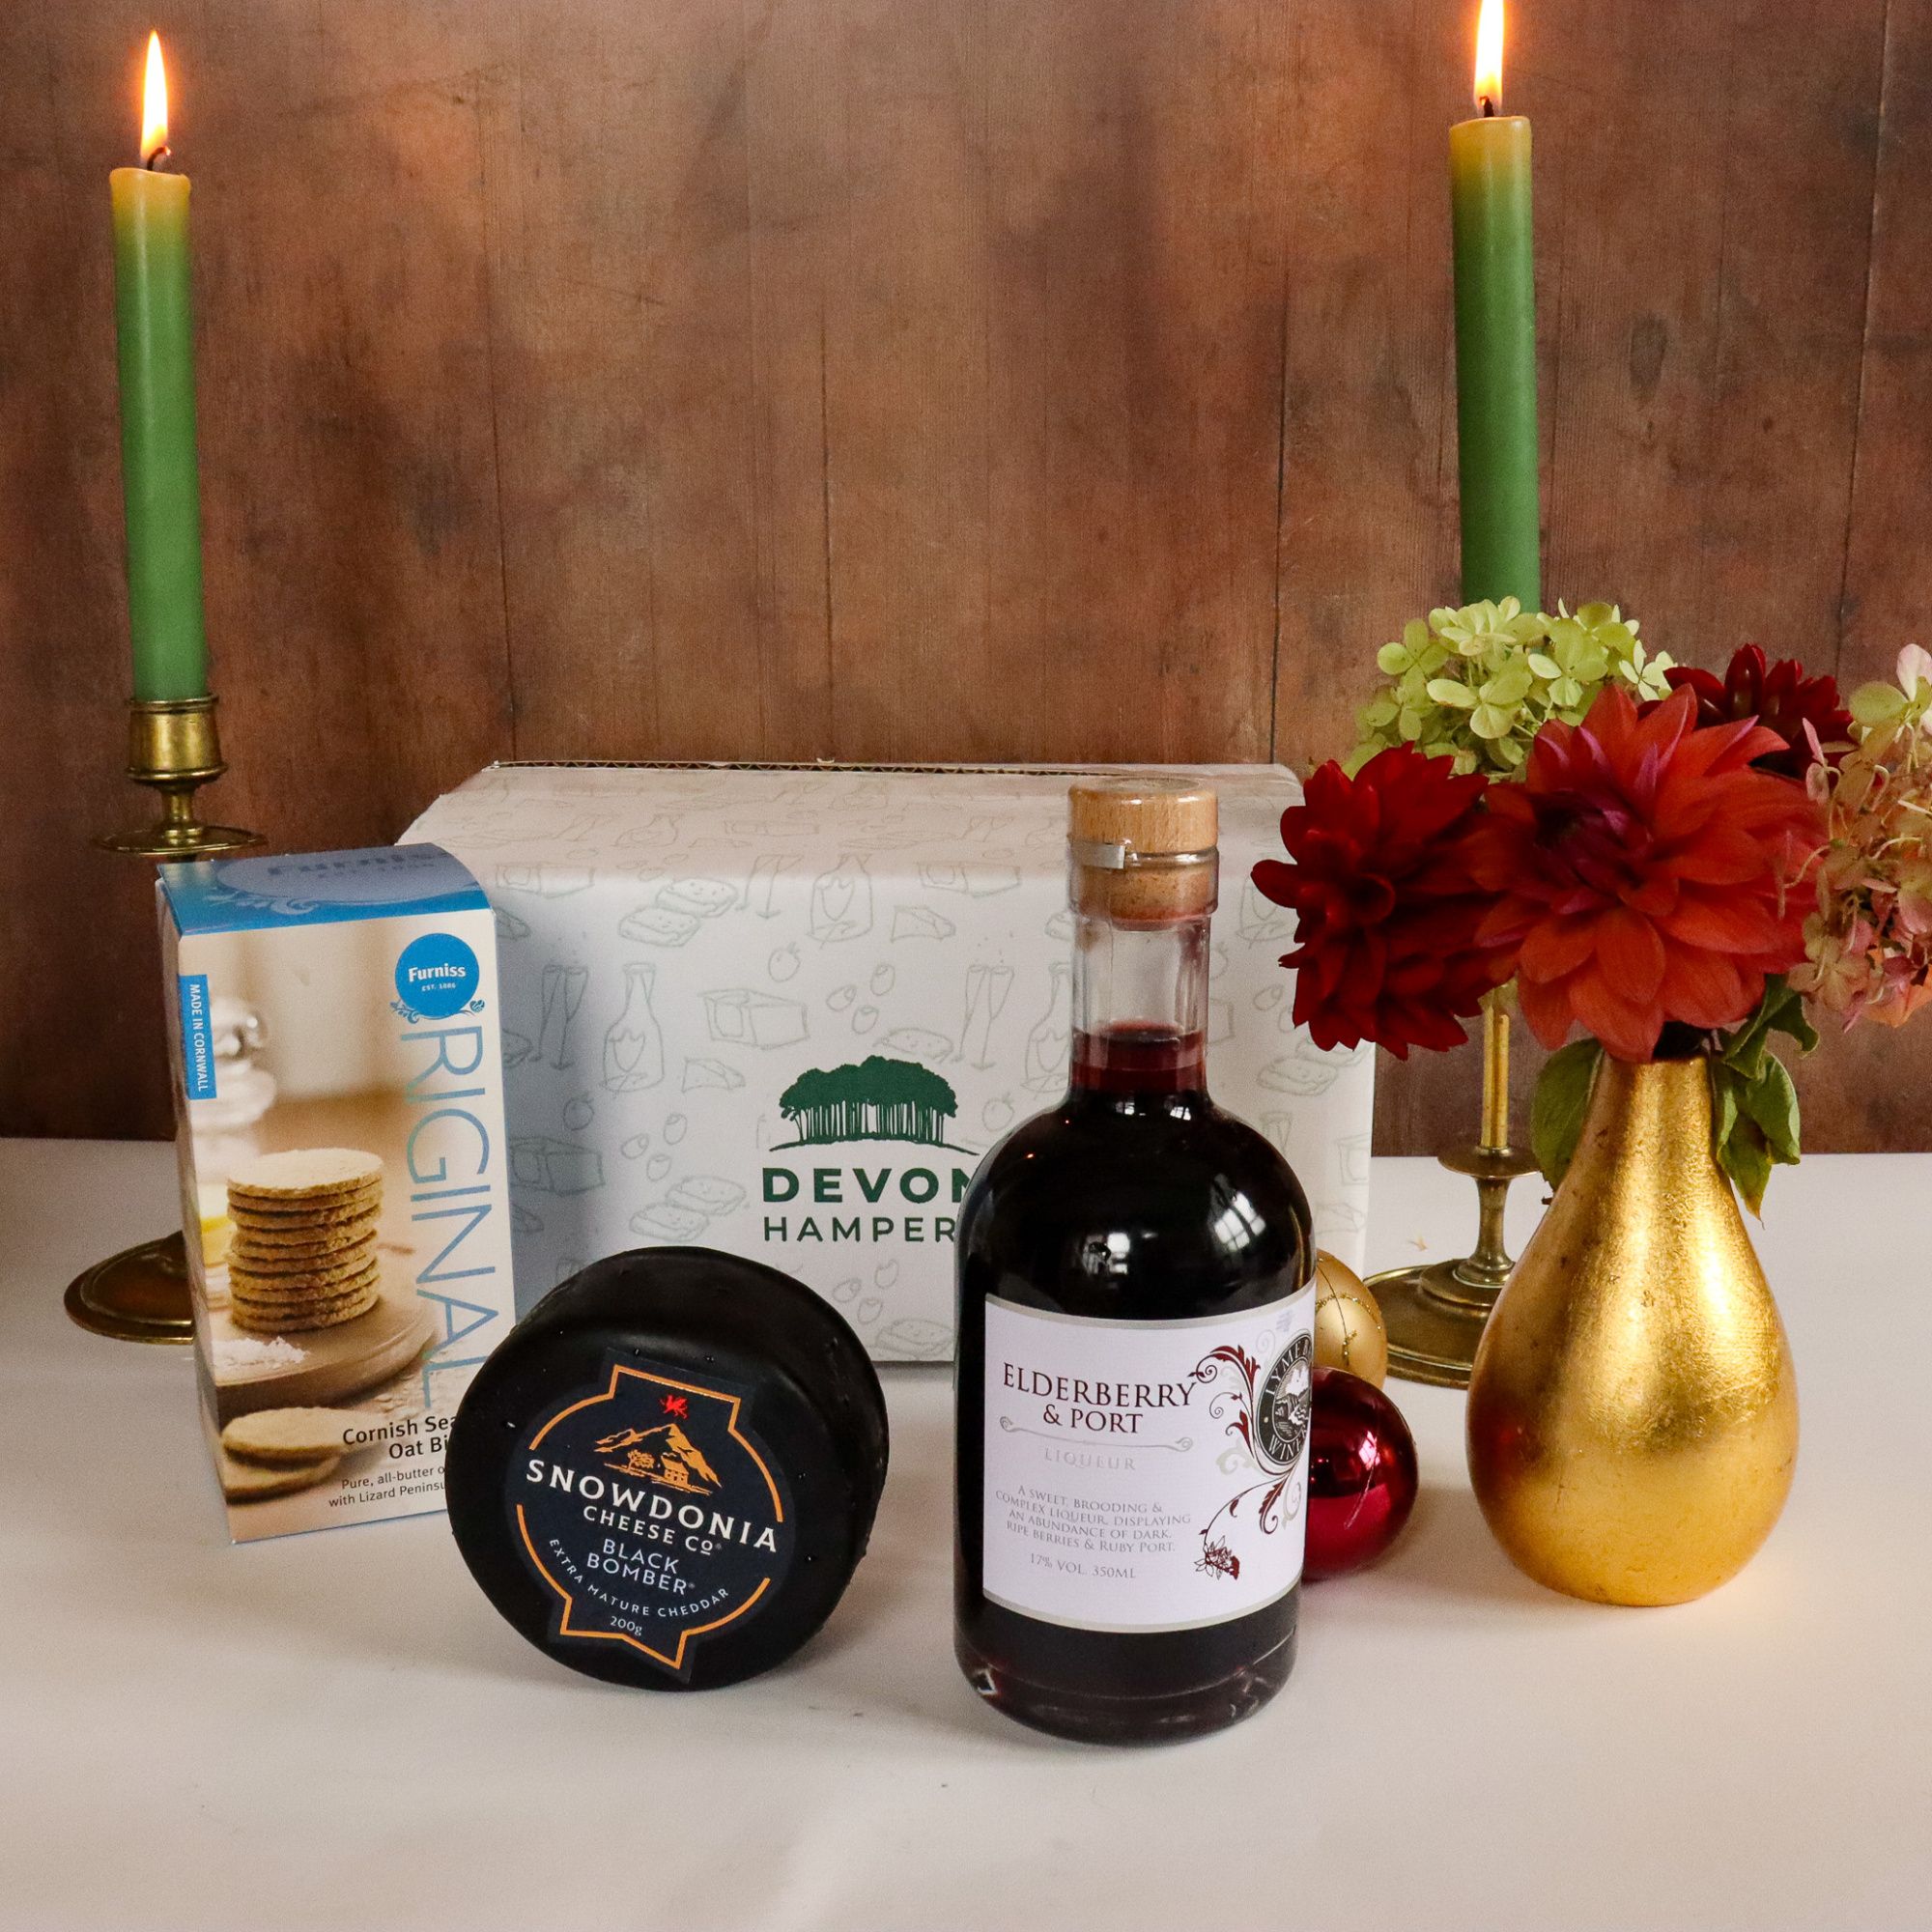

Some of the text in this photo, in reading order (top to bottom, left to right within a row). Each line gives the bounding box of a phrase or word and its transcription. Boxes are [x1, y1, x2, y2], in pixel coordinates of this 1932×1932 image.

[408, 963, 467, 982] Furniss
[189, 984, 209, 1092] MADE IN CORNWALL
[1003, 1362, 1197, 1407] ELDERBERRY
[343, 1419, 418, 1445] Cornish
[1042, 1404, 1144, 1434] & PORT
[388, 1440, 424, 1460] Oat
[1044, 1447, 1136, 1470] LIQUEUR
[342, 1478, 374, 1490] Pure,
[378, 1467, 434, 1485] all-butter
[328, 1494, 355, 1507] with
[359, 1488, 395, 1503] Lizard
[526, 1459, 777, 1552] SNOWDONIA
[995, 1490, 1046, 1515] COMPLEX
[1114, 1514, 1192, 1527] DISPLAYING
[1018, 1485, 1027, 1495] A
[1073, 1500, 1148, 1514] BROODING
[1151, 1502, 1163, 1513] &
[583, 1505, 676, 1545] CHEESE
[1007, 1520, 1029, 1537] RIPE
[1033, 1530, 1080, 1548] BERRIES
[1084, 1539, 1095, 1550] &
[1009, 1509, 1024, 1521] AN
[1028, 1516, 1105, 1538] ABUNDANCE
[1110, 1529, 1128, 1540] OF
[602, 1538, 680, 1575] BLACK
[549, 1539, 729, 1617] EXTRA MATURE CHEDDAR
[1092, 1565, 1137, 1579] 350ML
[610, 1616, 643, 1636] 200g
